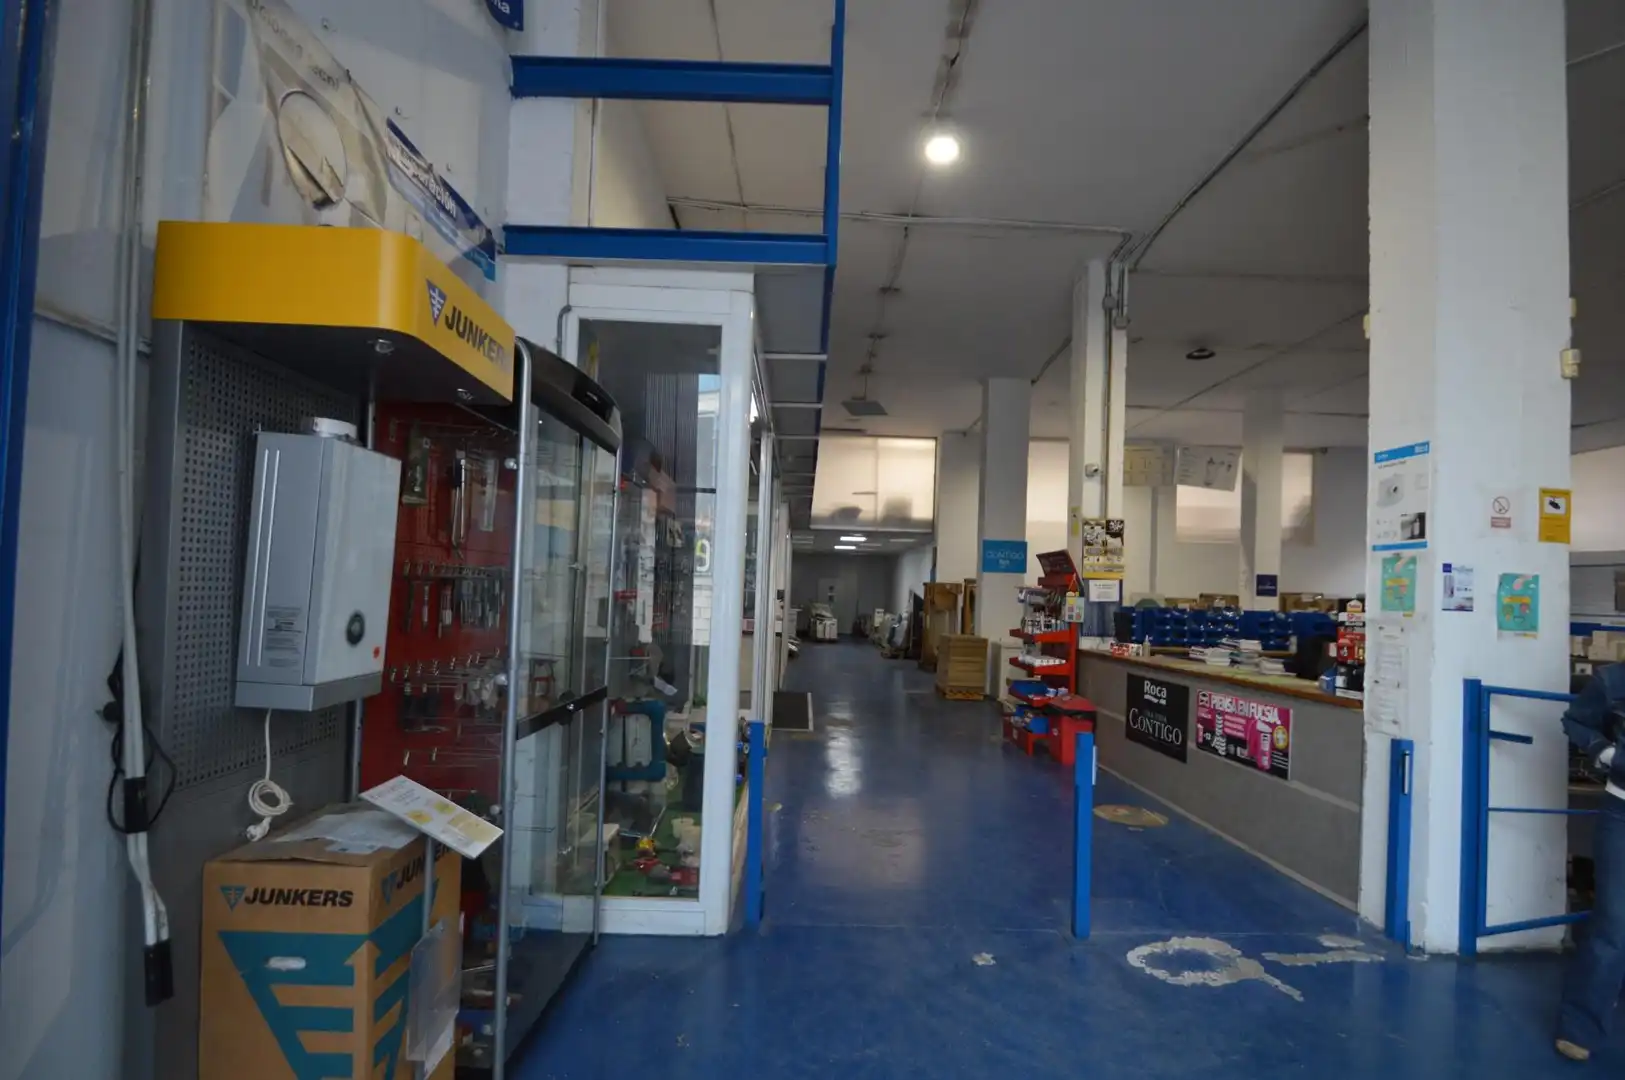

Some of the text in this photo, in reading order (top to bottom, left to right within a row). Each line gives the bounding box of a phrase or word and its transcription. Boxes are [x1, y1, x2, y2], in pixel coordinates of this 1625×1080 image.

[1144, 680, 1167, 699] Roca
[1129, 707, 1182, 745] CONTIGO
[245, 886, 353, 908] JUNKERS
